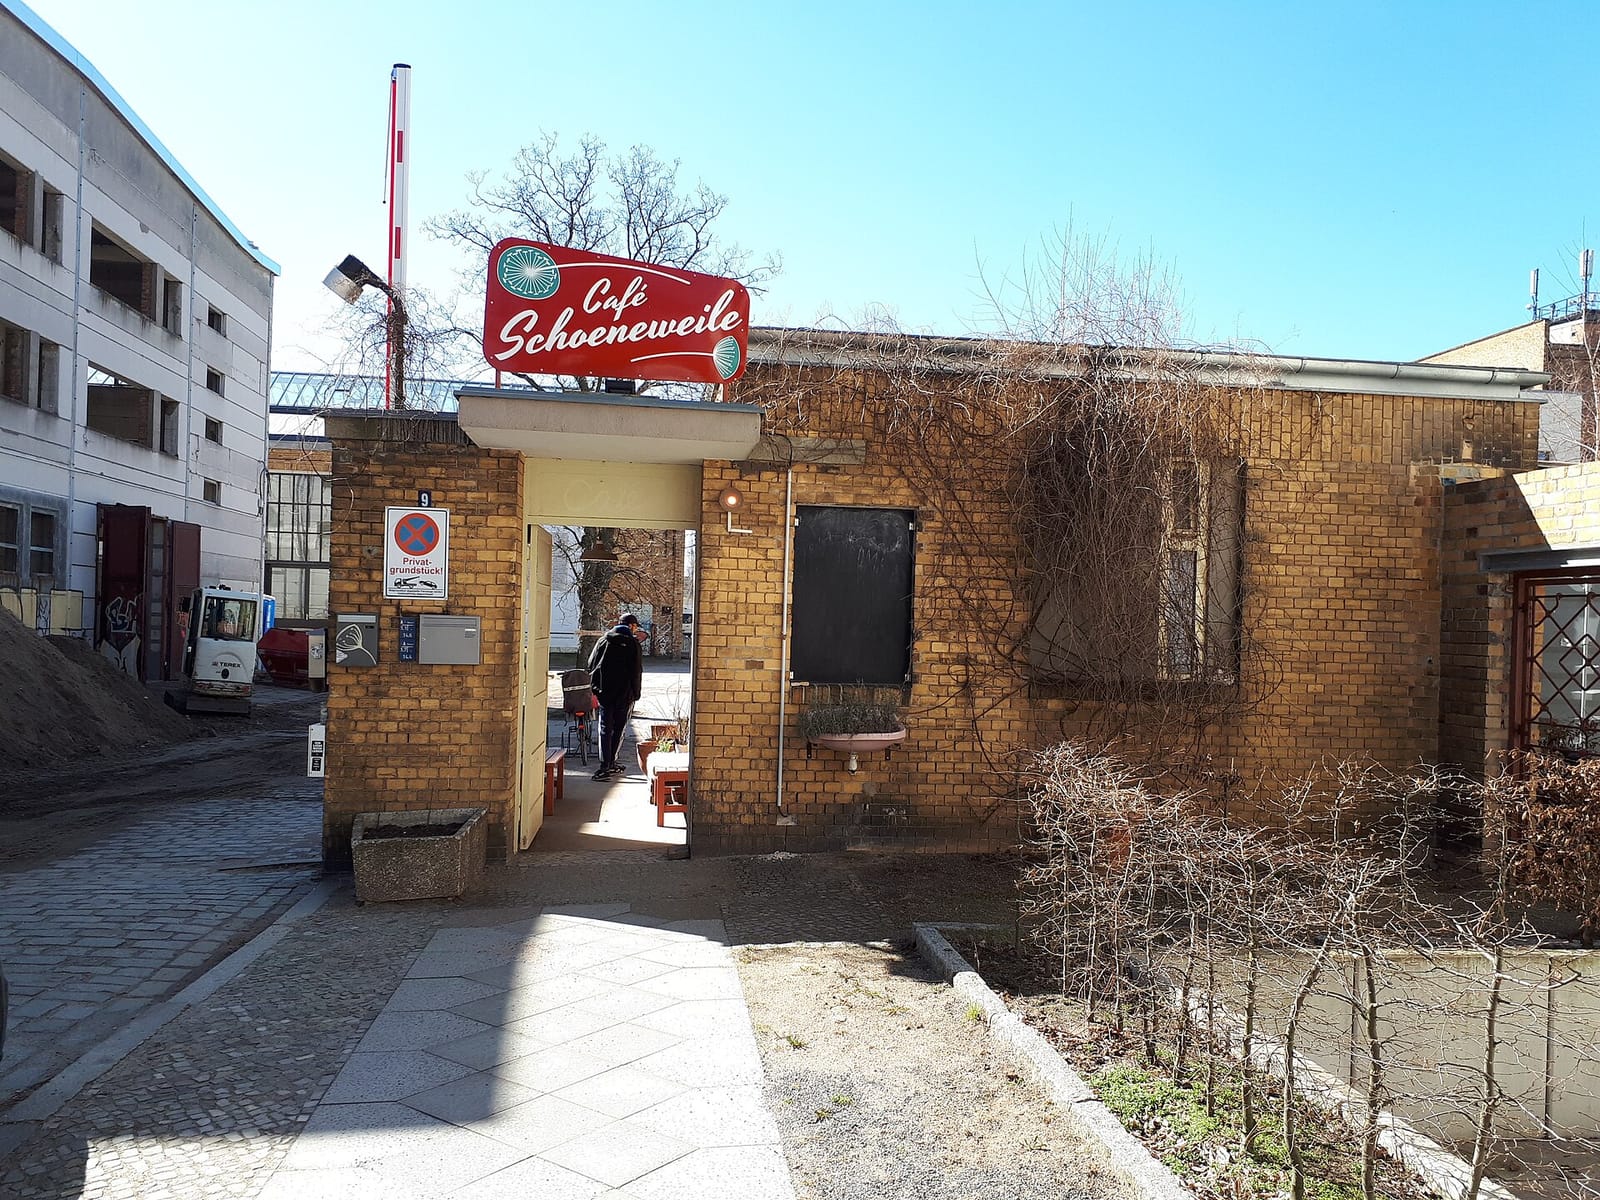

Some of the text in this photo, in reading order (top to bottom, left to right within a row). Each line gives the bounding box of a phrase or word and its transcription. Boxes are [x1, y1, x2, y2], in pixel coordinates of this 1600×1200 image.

[583, 275, 648, 321] Café
[494, 288, 743, 361] Schoeneweile
[421, 493, 429, 507] 9
[402, 557, 433, 566] Privat-
[389, 566, 443, 575] grundstück!
